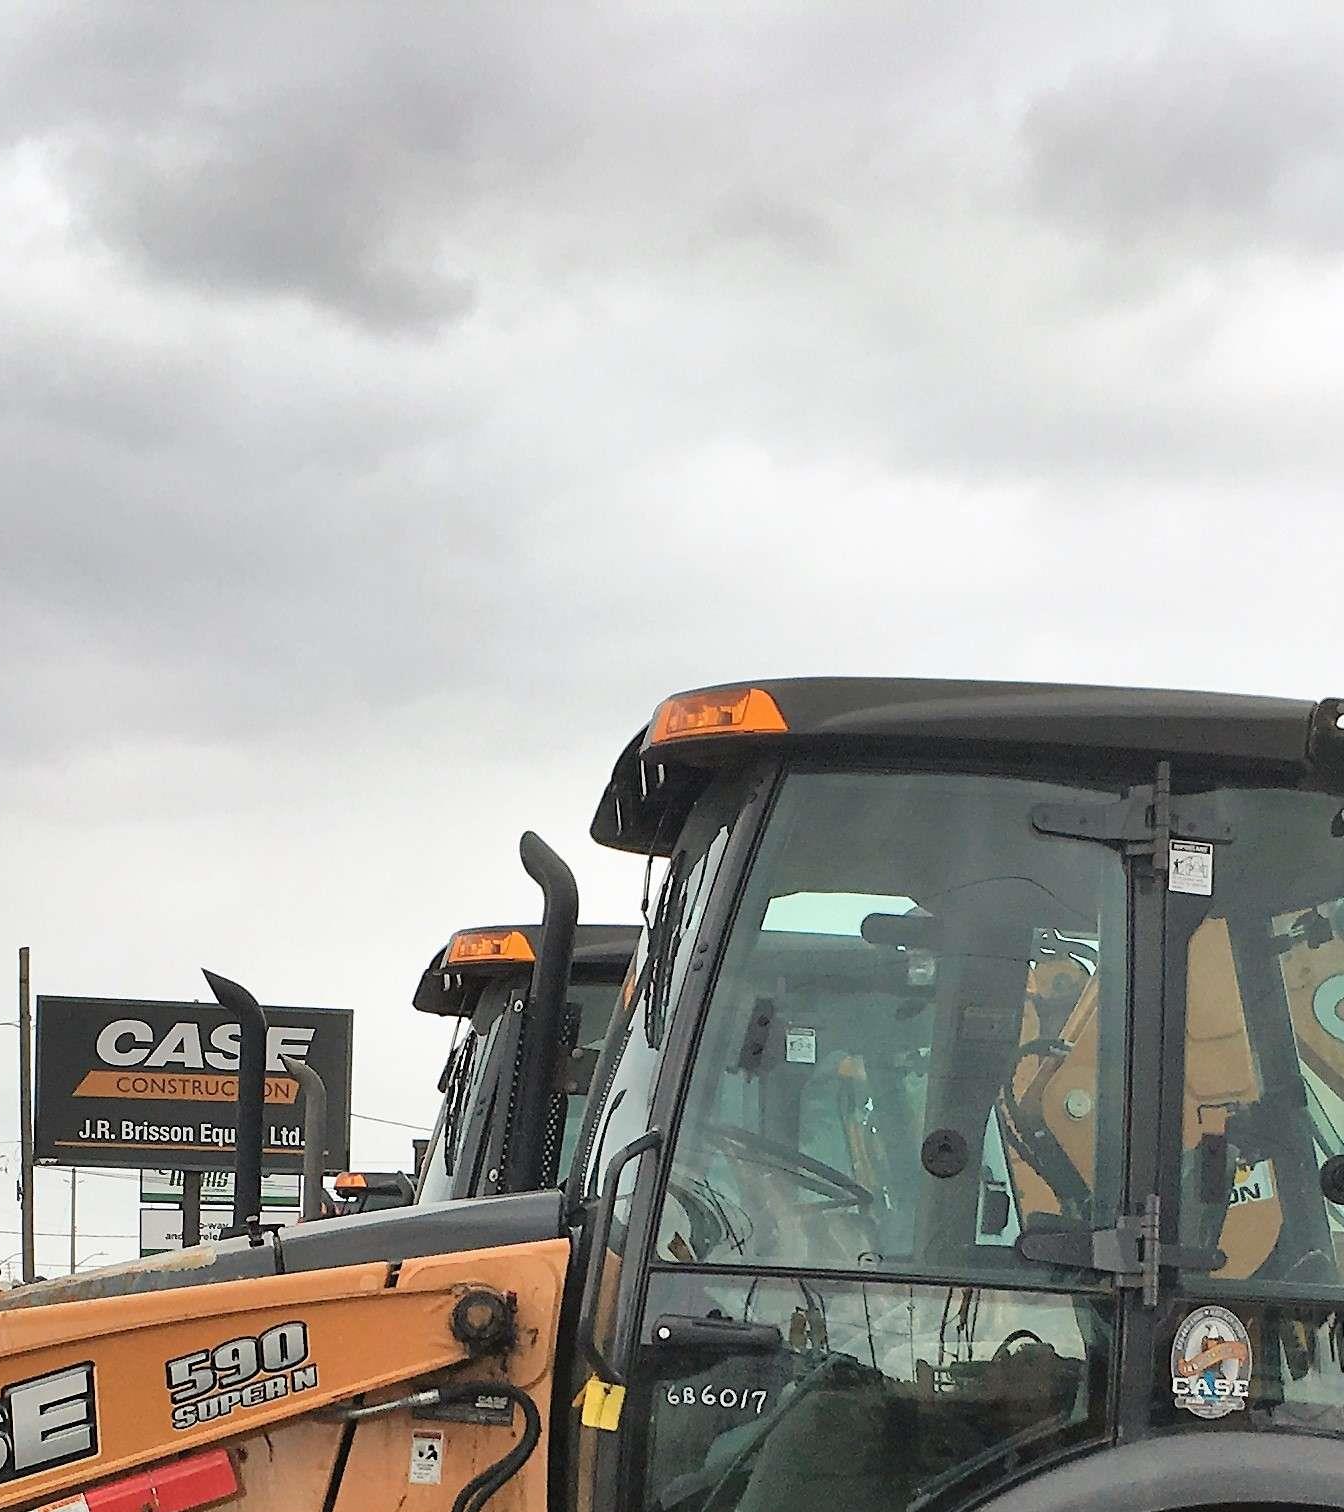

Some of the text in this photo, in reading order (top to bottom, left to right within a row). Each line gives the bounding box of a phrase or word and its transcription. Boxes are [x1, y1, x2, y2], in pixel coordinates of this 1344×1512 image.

[96, 1019, 316, 1072] CASE
[116, 1077, 290, 1099] CONSTRUCON
[78, 1120, 116, 1140] J.R.
[121, 1121, 194, 1143] Brisson
[270, 1125, 306, 1147] Ltd.
[166, 1321, 308, 1404] 590
[172, 1363, 318, 1429] SUPER N
[1172, 1377, 1249, 1397] CASE
